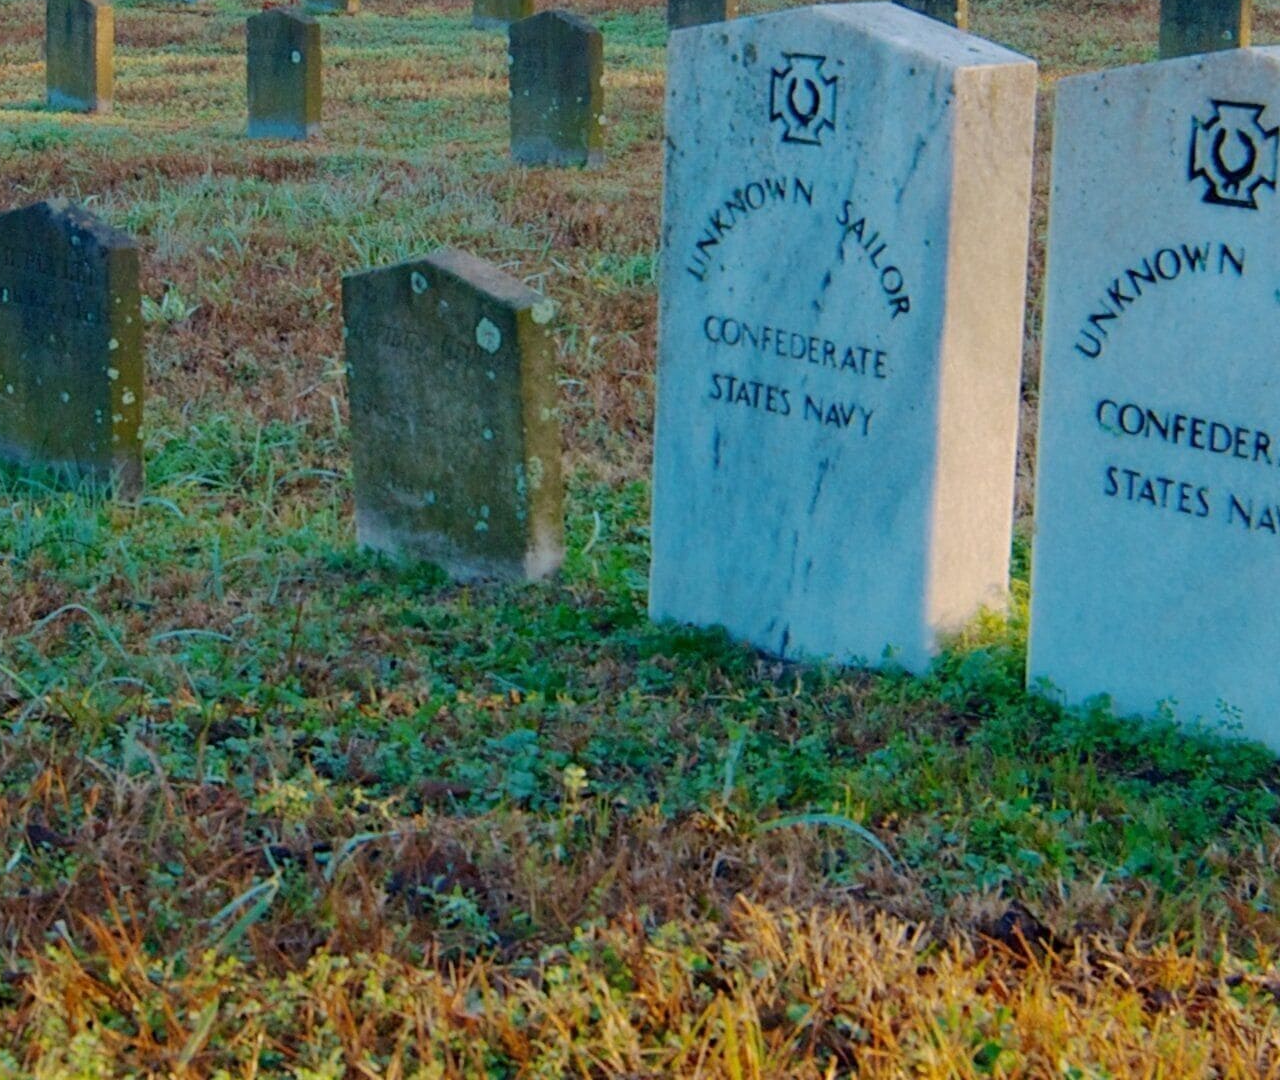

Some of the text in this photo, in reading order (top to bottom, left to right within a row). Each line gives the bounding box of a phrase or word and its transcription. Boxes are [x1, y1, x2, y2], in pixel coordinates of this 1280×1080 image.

[687, 175, 911, 320] UNKNOWN SAILOR
[1074, 241, 1246, 359] UNKNOWN
[703, 315, 889, 380] CONFEDERATE
[709, 373, 875, 437] STATES NAVY
[1103, 465, 1211, 518] STATES
